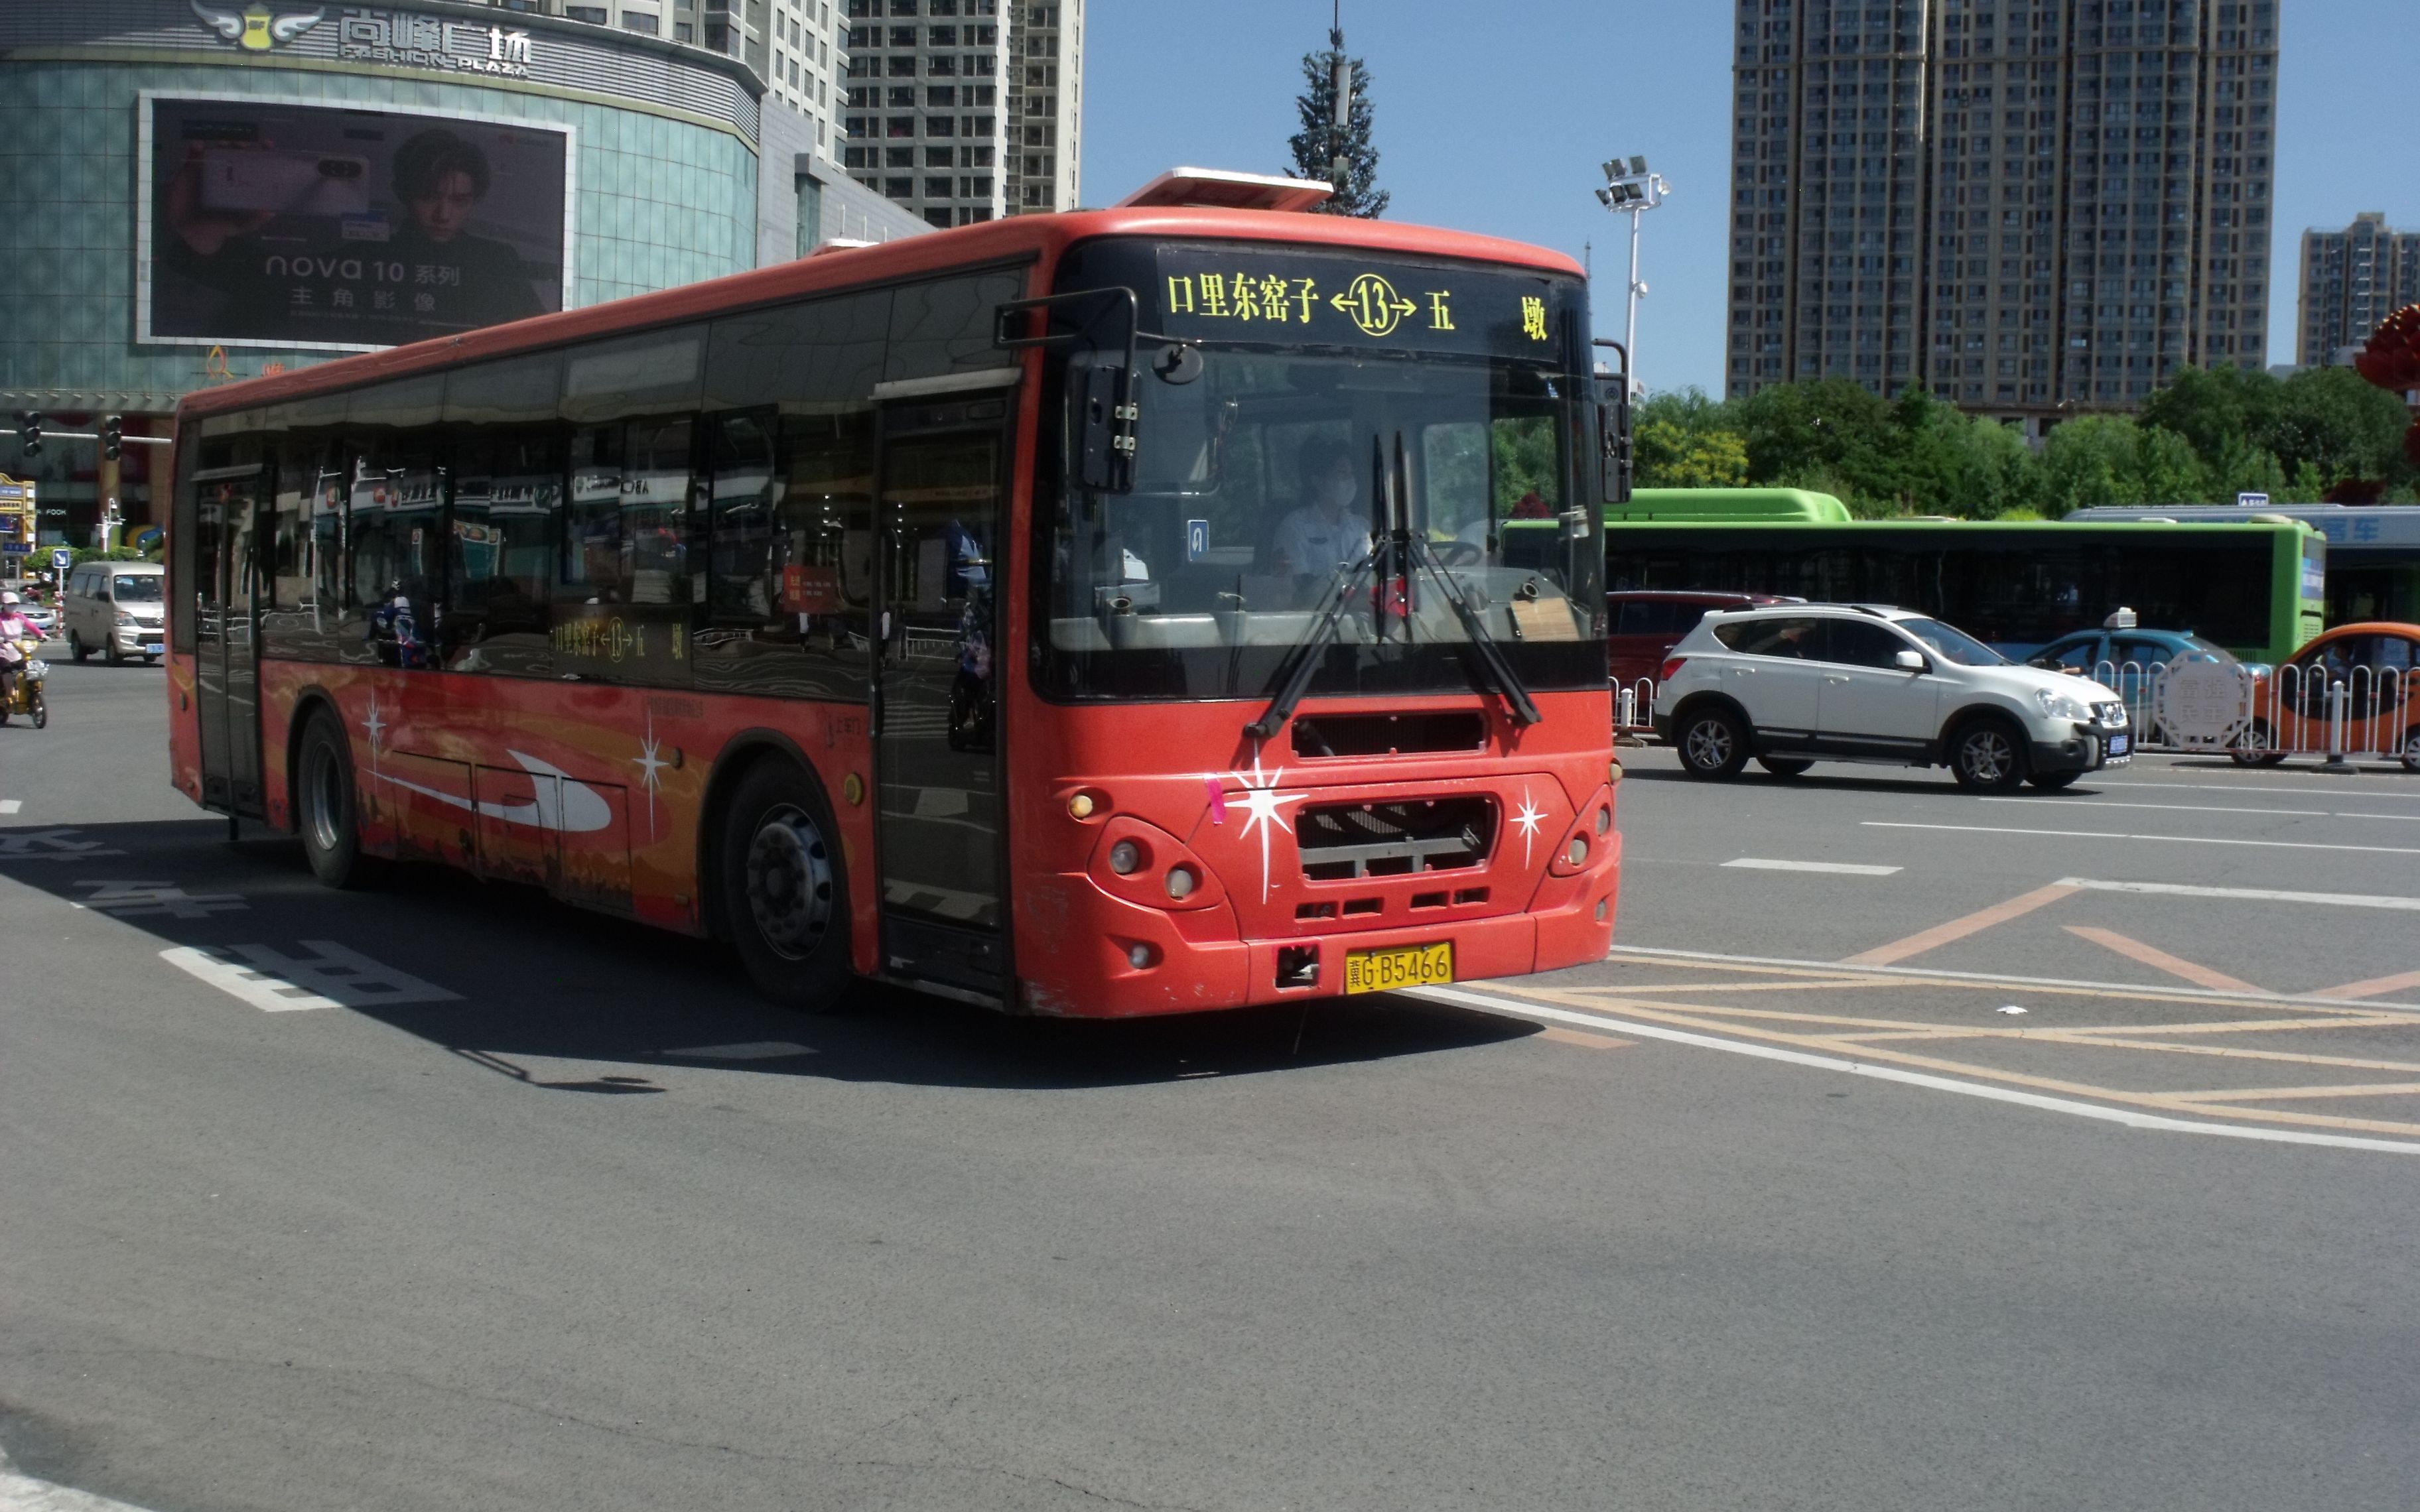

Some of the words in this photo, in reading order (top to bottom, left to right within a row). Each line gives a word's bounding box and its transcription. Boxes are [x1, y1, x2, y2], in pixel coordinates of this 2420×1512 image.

[340, 8, 532, 64] 尚峰广场
[340, 43, 448, 67] FASHION
[456, 56, 530, 76] PLAZA
[265, 255, 362, 280] nova
[373, 261, 405, 283] 10
[413, 264, 460, 287] 系列
[1167, 272, 1320, 324] 口里东窑子
[1356, 280, 1389, 330] 13
[2180, 678, 2226, 699] 富强
[2180, 703, 2226, 724] 民主
